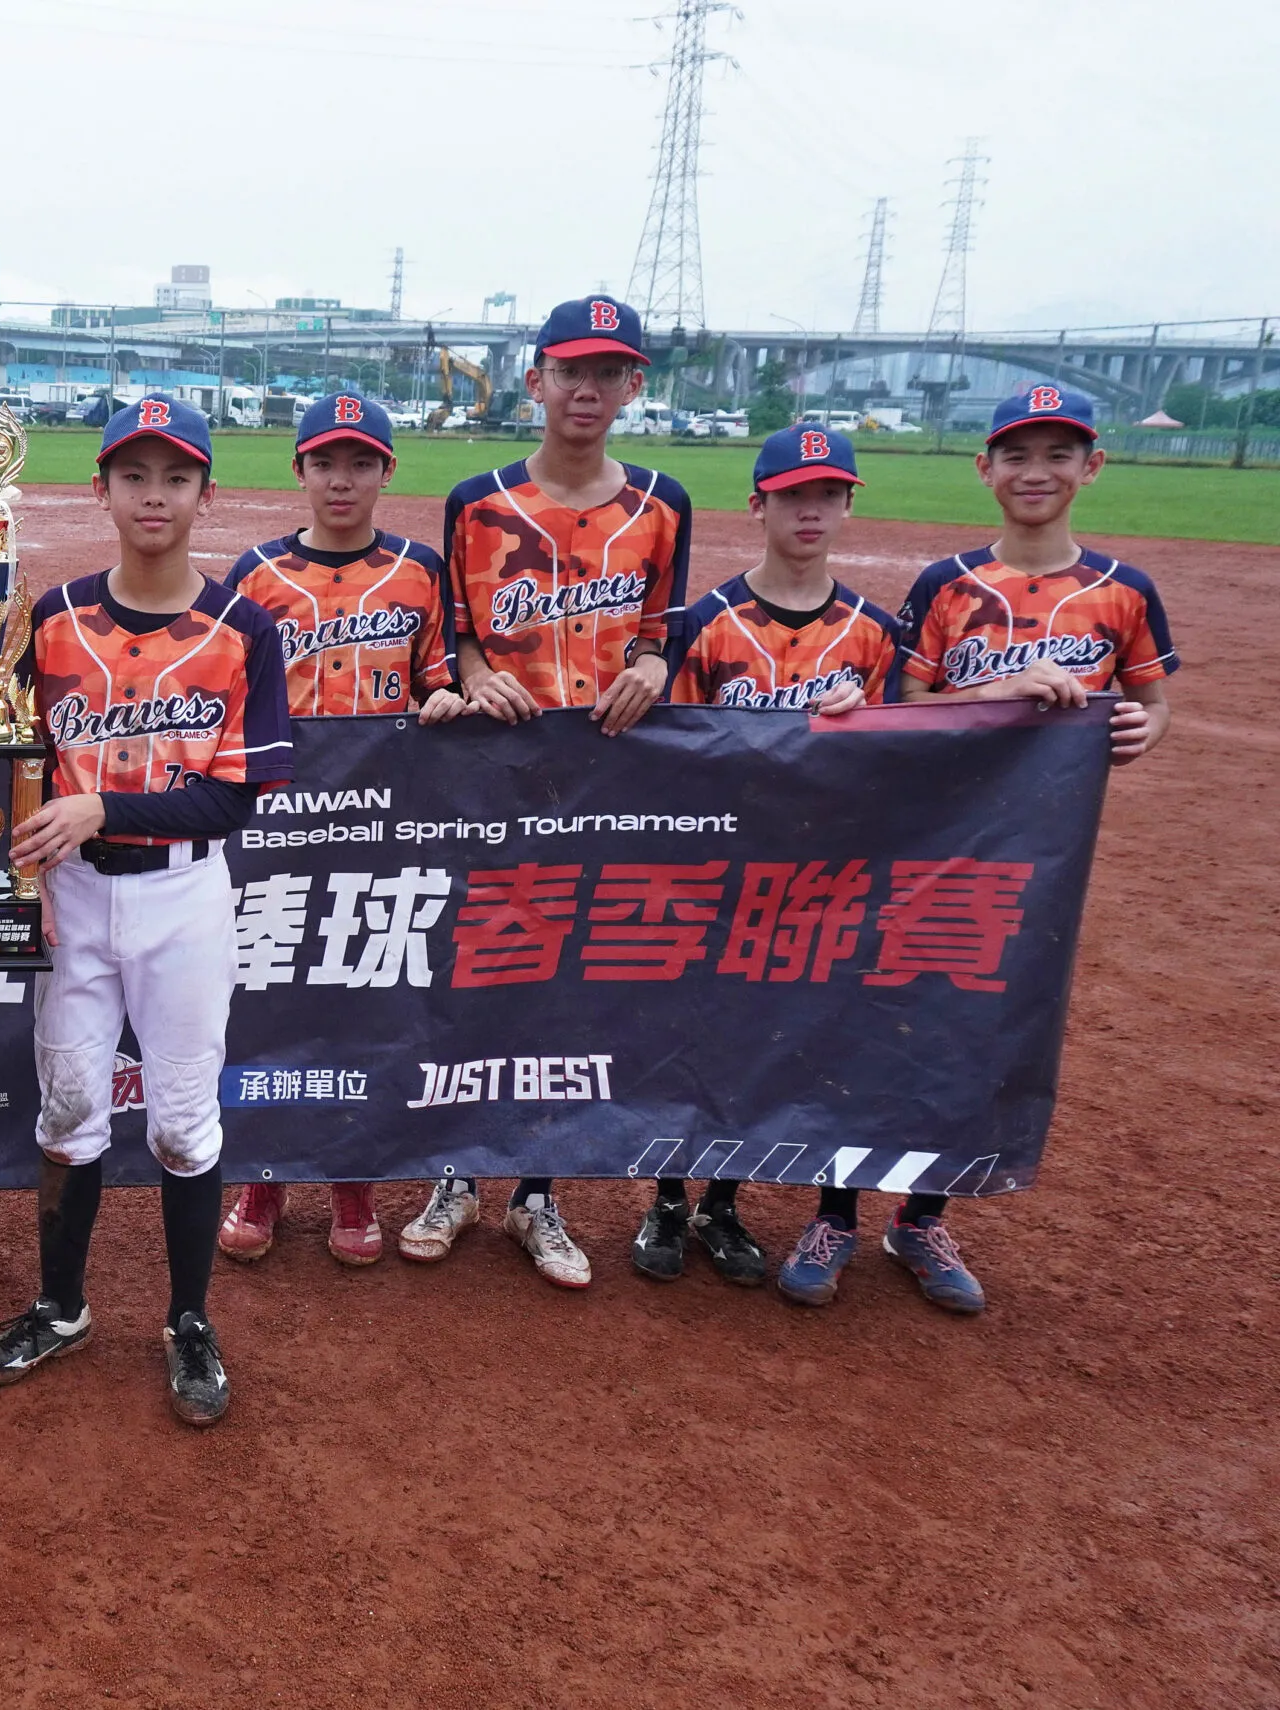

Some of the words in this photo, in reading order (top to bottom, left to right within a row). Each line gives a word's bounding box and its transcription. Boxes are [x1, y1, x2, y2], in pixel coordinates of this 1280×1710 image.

[591, 301, 621, 331] B
[137, 398, 171, 428] B
[335, 396, 364, 423] B
[1029, 385, 1062, 412] B
[801, 430, 830, 460] B
[491, 571, 646, 636] Braves
[278, 607, 420, 668] Braves
[943, 634, 1114, 688] Braves
[372, 669, 401, 700] 18
[50, 692, 226, 750] Braves
[255, 789, 391, 815] TAIWAN
[241, 821, 383, 849] Baseball
[394, 818, 507, 843] Spring
[518, 812, 737, 836] Tournament
[240, 1069, 368, 1101] 承辦單位
[407, 1058, 507, 1108] JUST
[511, 1055, 613, 1100] BEST
